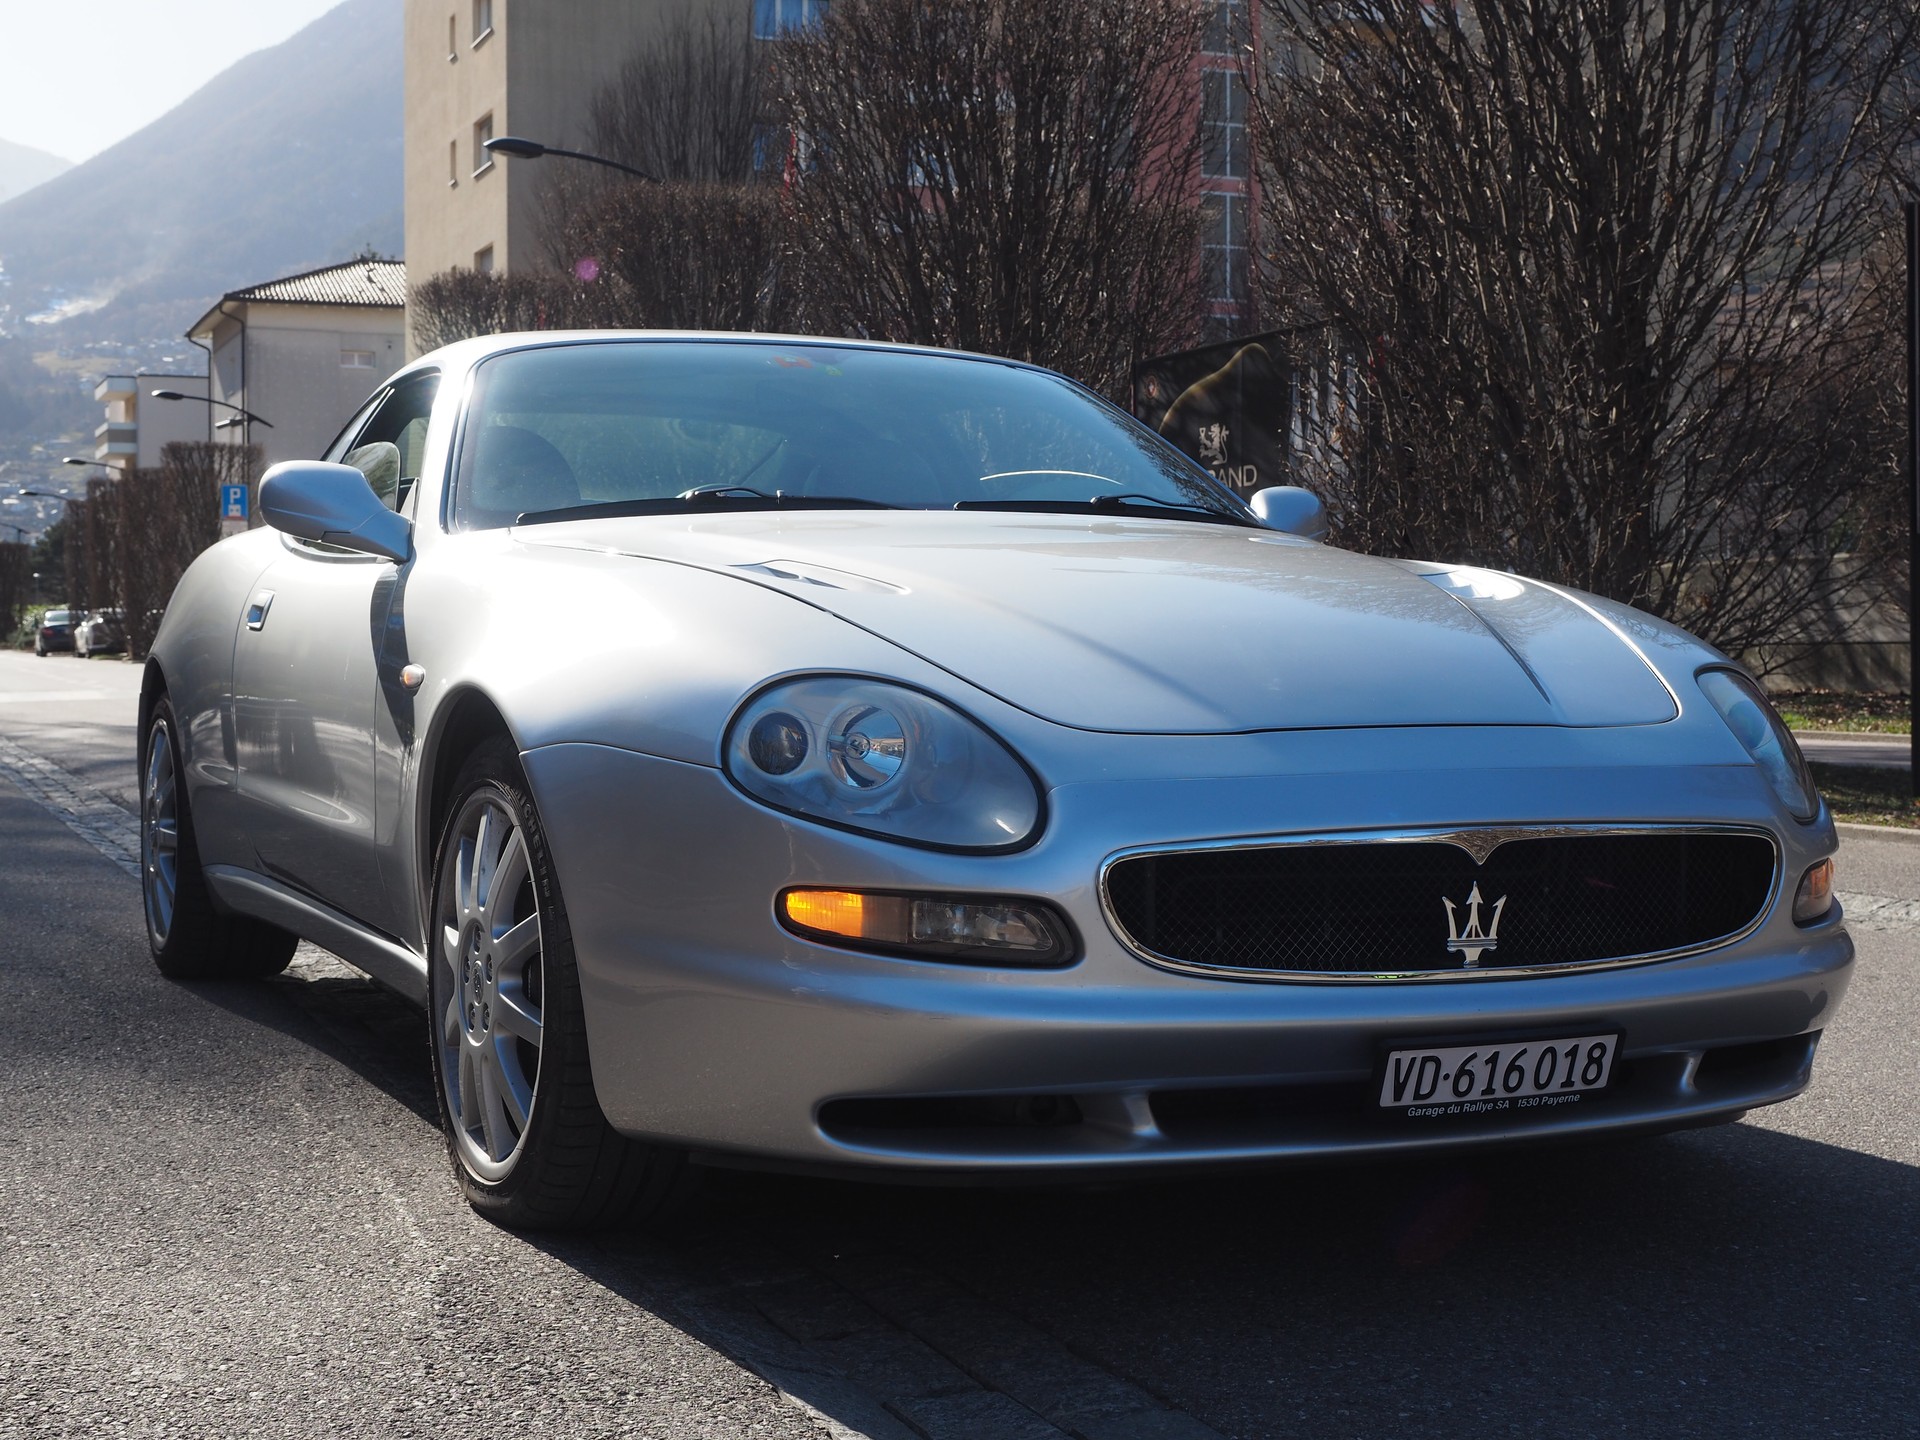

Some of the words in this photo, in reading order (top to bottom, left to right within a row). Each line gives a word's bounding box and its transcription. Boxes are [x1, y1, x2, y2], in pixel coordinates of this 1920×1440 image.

[230, 487, 241, 504] P
[1407, 1107, 1445, 1117] Garage
[1447, 1104, 1461, 1114] du
[1463, 1101, 1494, 1113] Rallye
[1496, 1100, 1510, 1109] SA
[1517, 1097, 1540, 1108] 1530
[1541, 1094, 1580, 1106] Payerne
